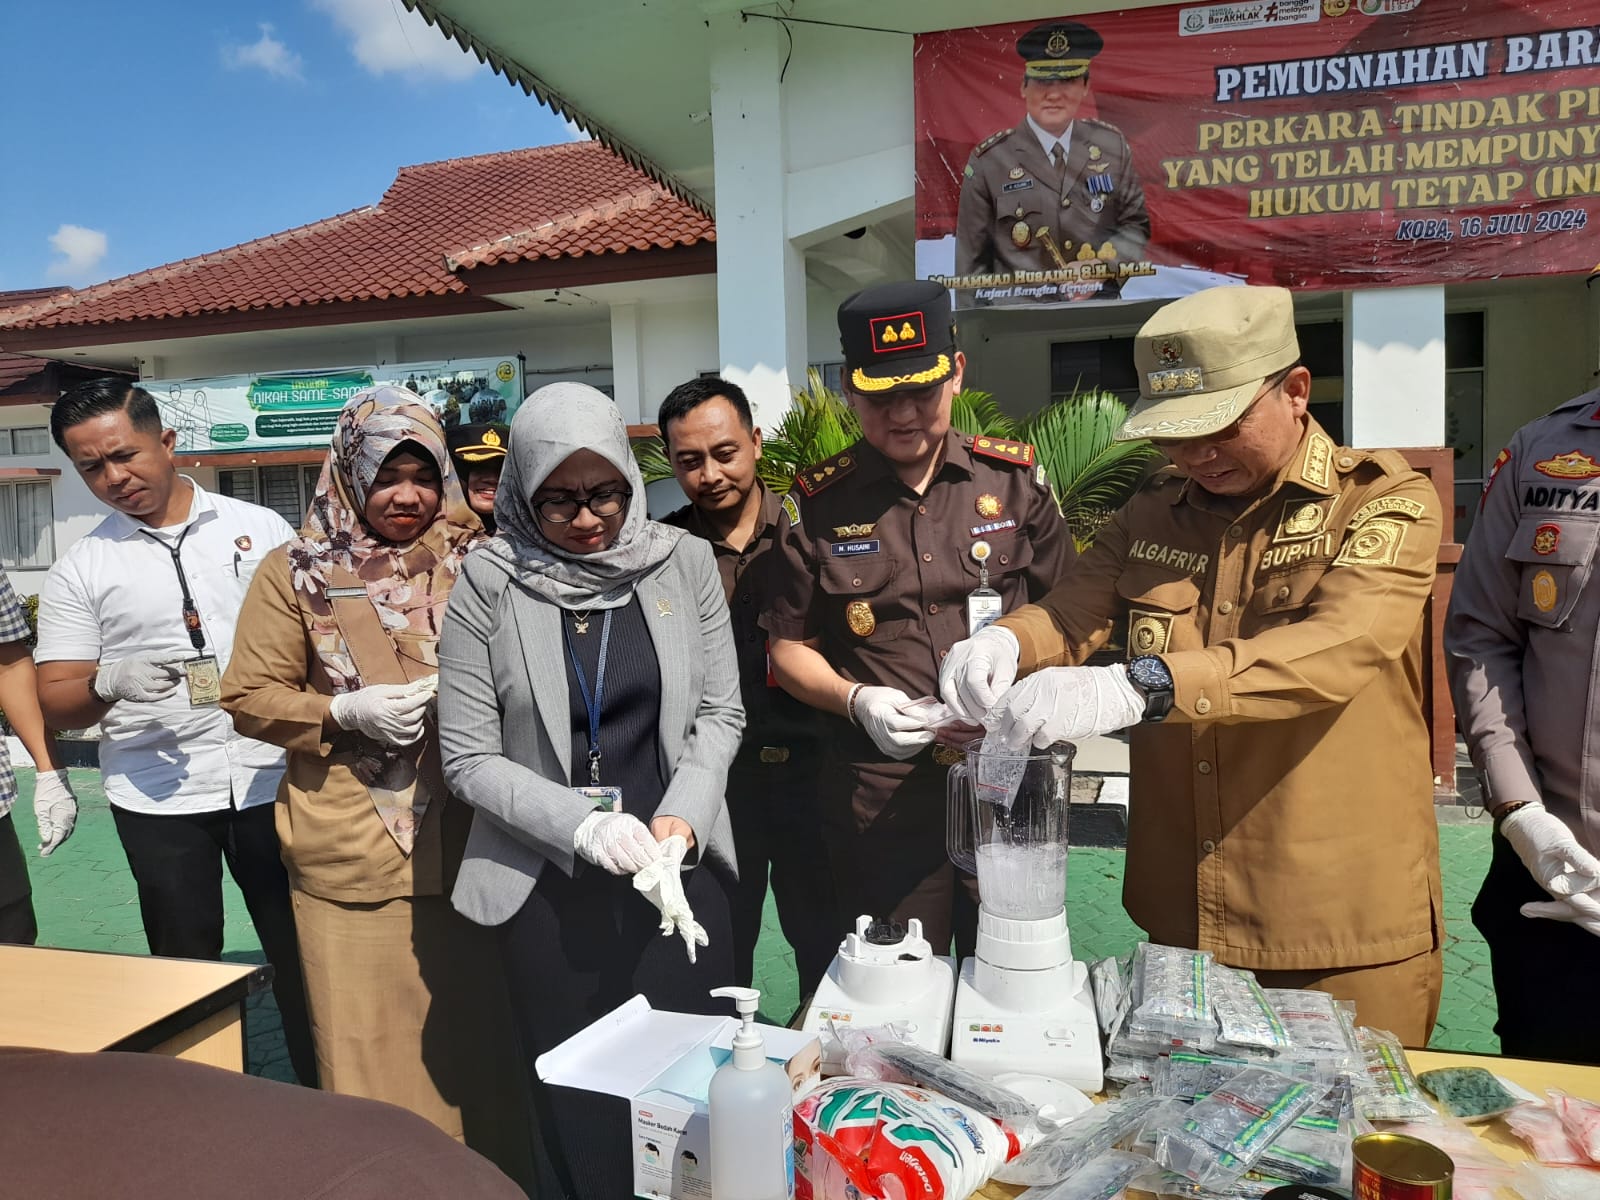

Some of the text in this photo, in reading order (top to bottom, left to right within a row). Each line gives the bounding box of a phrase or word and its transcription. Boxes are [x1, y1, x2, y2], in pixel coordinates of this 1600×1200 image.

[1208, 12, 1260, 24] BerAKHLAK
[1278, 13, 1308, 21] bangsa
[1279, 4, 1315, 14] melayani
[1216, 40, 1488, 101] PEMUSNAHAN
[1198, 108, 1384, 151] PERKARA
[1395, 93, 1545, 134] TINDAK
[1162, 126, 1600, 189] YANG TELAH MEMPUNY
[1249, 163, 1600, 218] HUKUM TETAP (IN
[1396, 208, 1587, 241] KOBA, 16 JULI 2024
[975, 282, 1103, 300] Kajari Bangka Tengah
[253, 391, 288, 404] NIKAH
[1523, 486, 1599, 511] ADITYA
[847, 543, 871, 552] HUSAINI
[1260, 533, 1331, 570] BUPATI
[638, 1117, 656, 1128] Masker
[656, 1122, 673, 1132] Bedah
[899, 1150, 934, 1193] Deterjen
